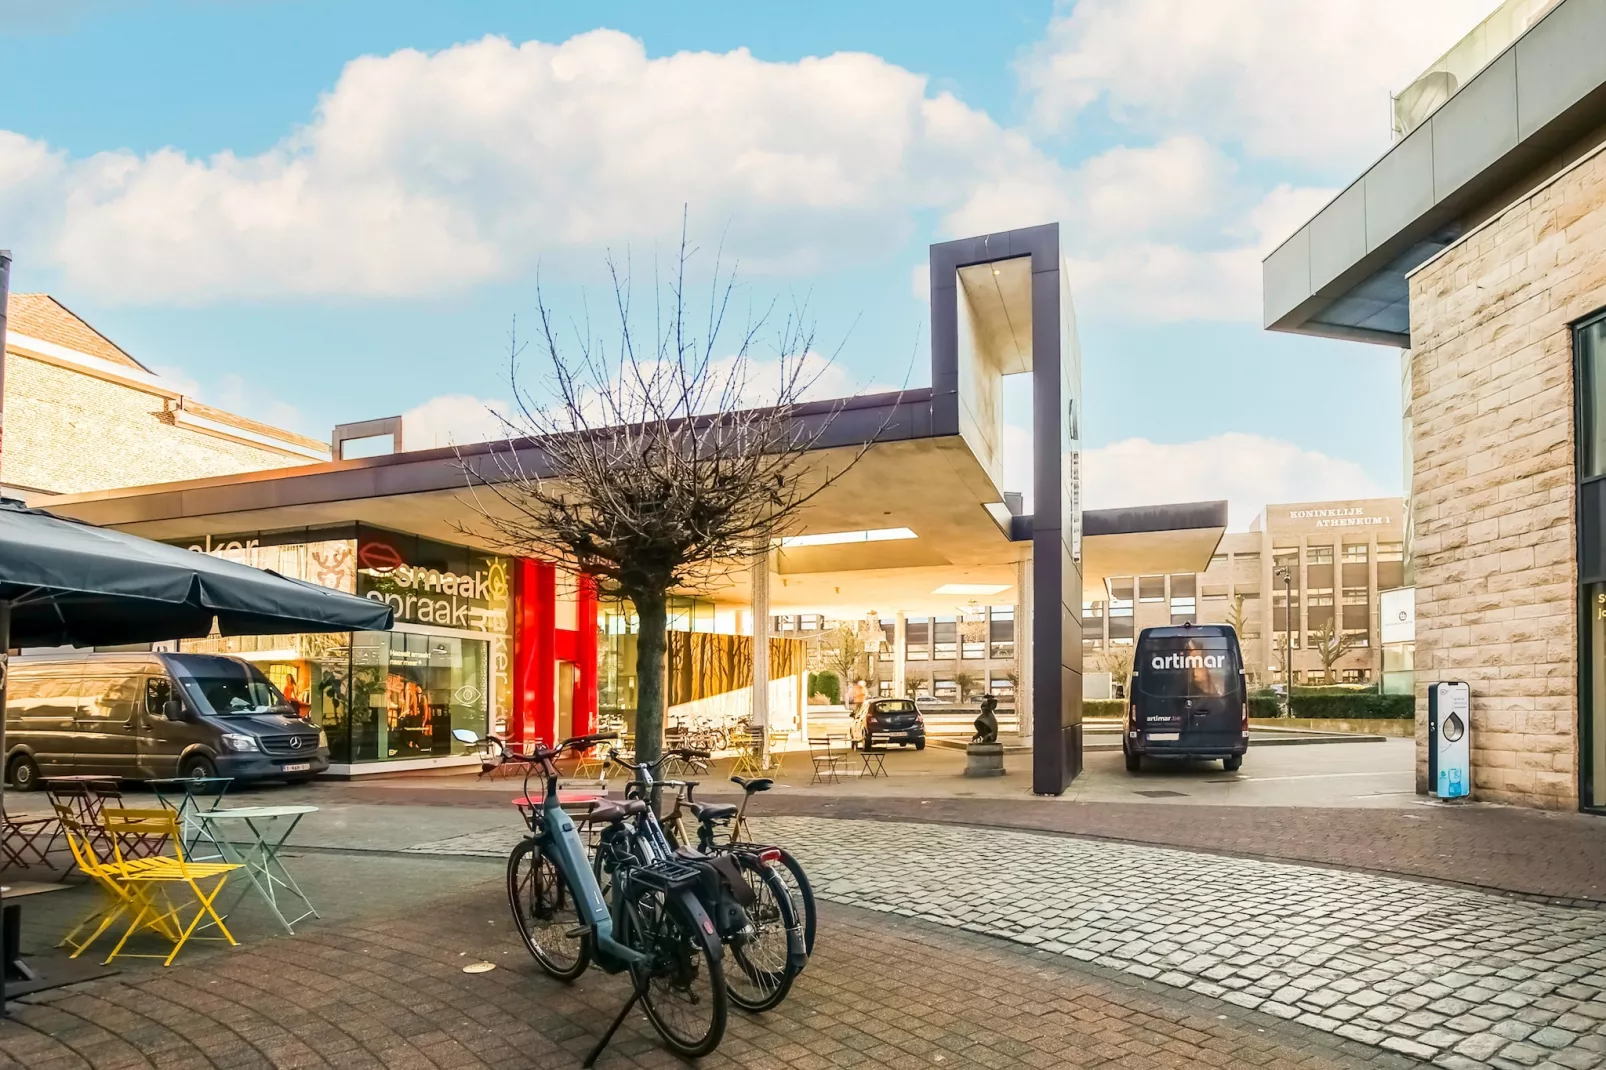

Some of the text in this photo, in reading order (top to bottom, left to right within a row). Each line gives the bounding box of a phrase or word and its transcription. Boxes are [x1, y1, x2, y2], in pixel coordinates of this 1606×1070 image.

[1290, 507, 1364, 519] KONINKLIJK
[1316, 517, 1382, 527] ATHENEUM
[395, 563, 490, 601] smaak
[1598, 593, 1606, 603] S
[1151, 652, 1225, 670] artimar
[1146, 714, 1181, 722] artimar.be
